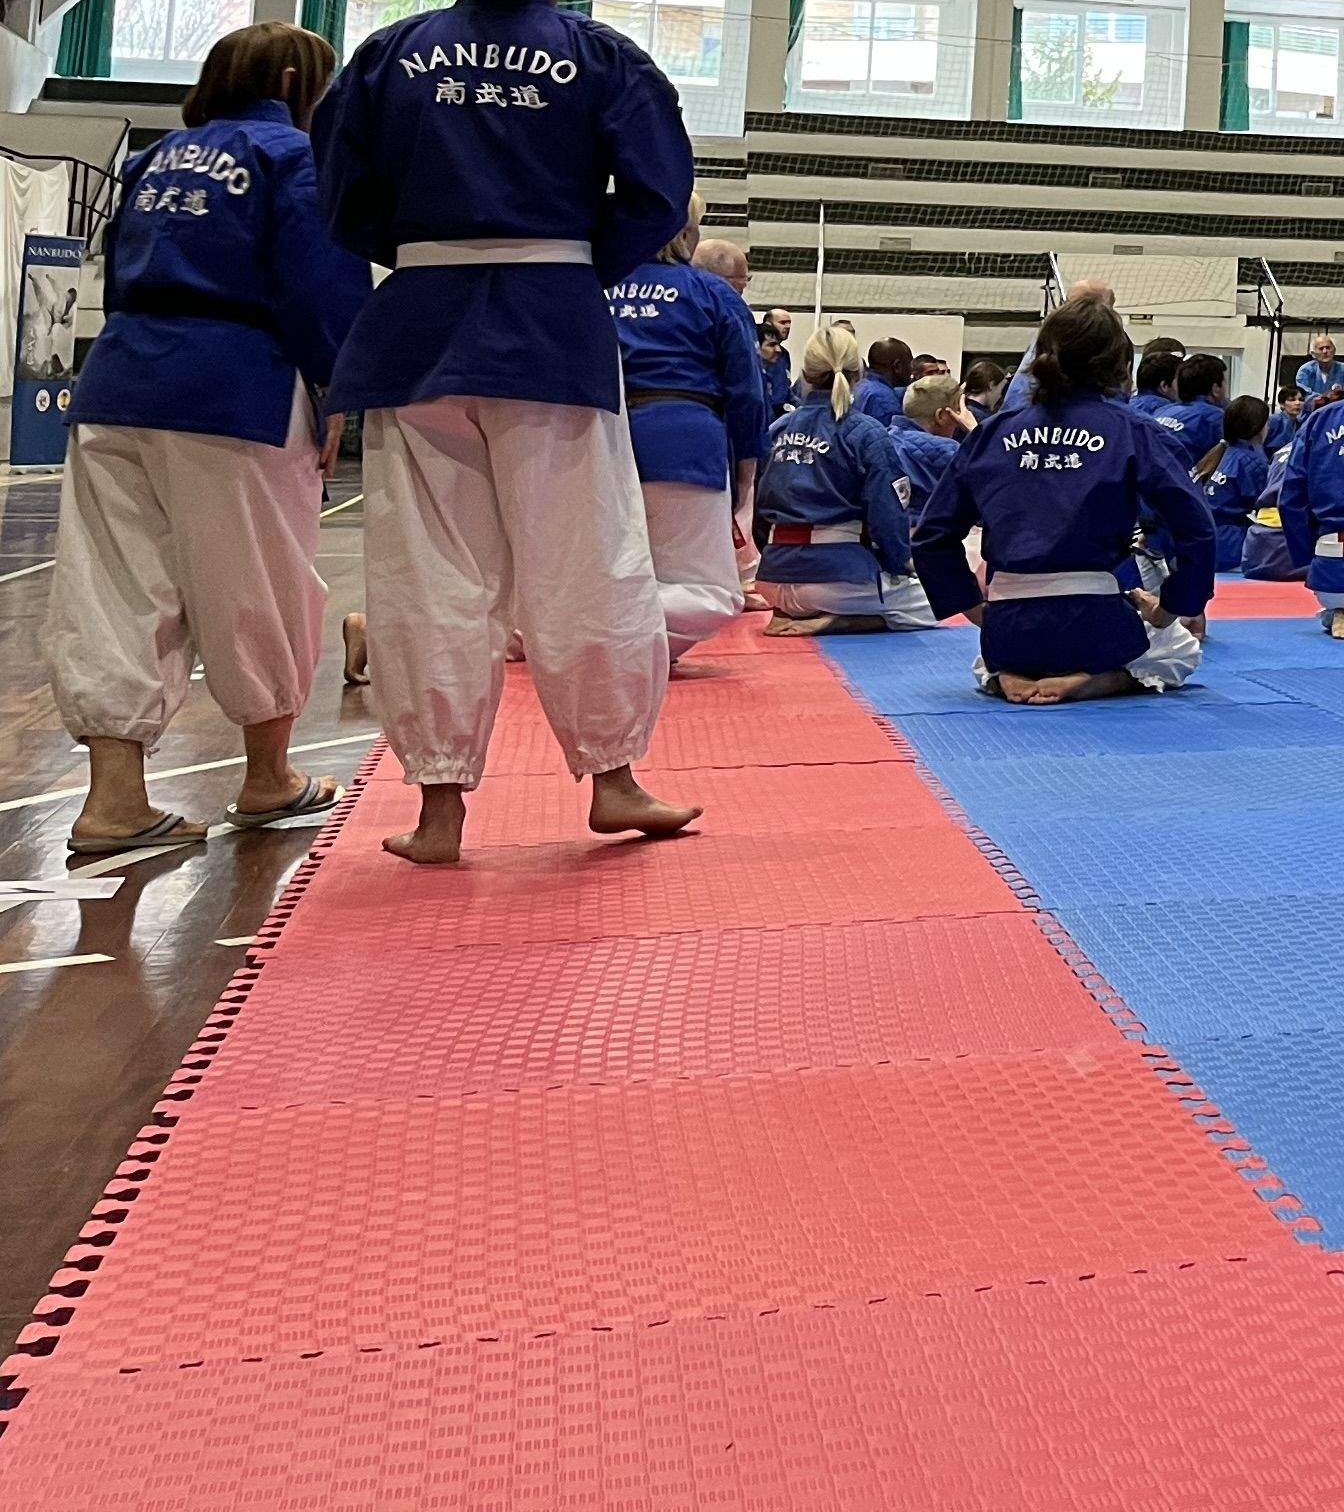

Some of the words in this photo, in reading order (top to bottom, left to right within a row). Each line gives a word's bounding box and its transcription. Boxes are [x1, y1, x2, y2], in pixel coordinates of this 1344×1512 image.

[399, 43, 577, 84] NANBUDO
[435, 77, 549, 108] 南武道
[141, 144, 250, 195] ANBUDO
[603, 282, 679, 303] NBUDO
[1003, 427, 1105, 453] NANBUDO
[1019, 451, 1083, 470] 南武道
